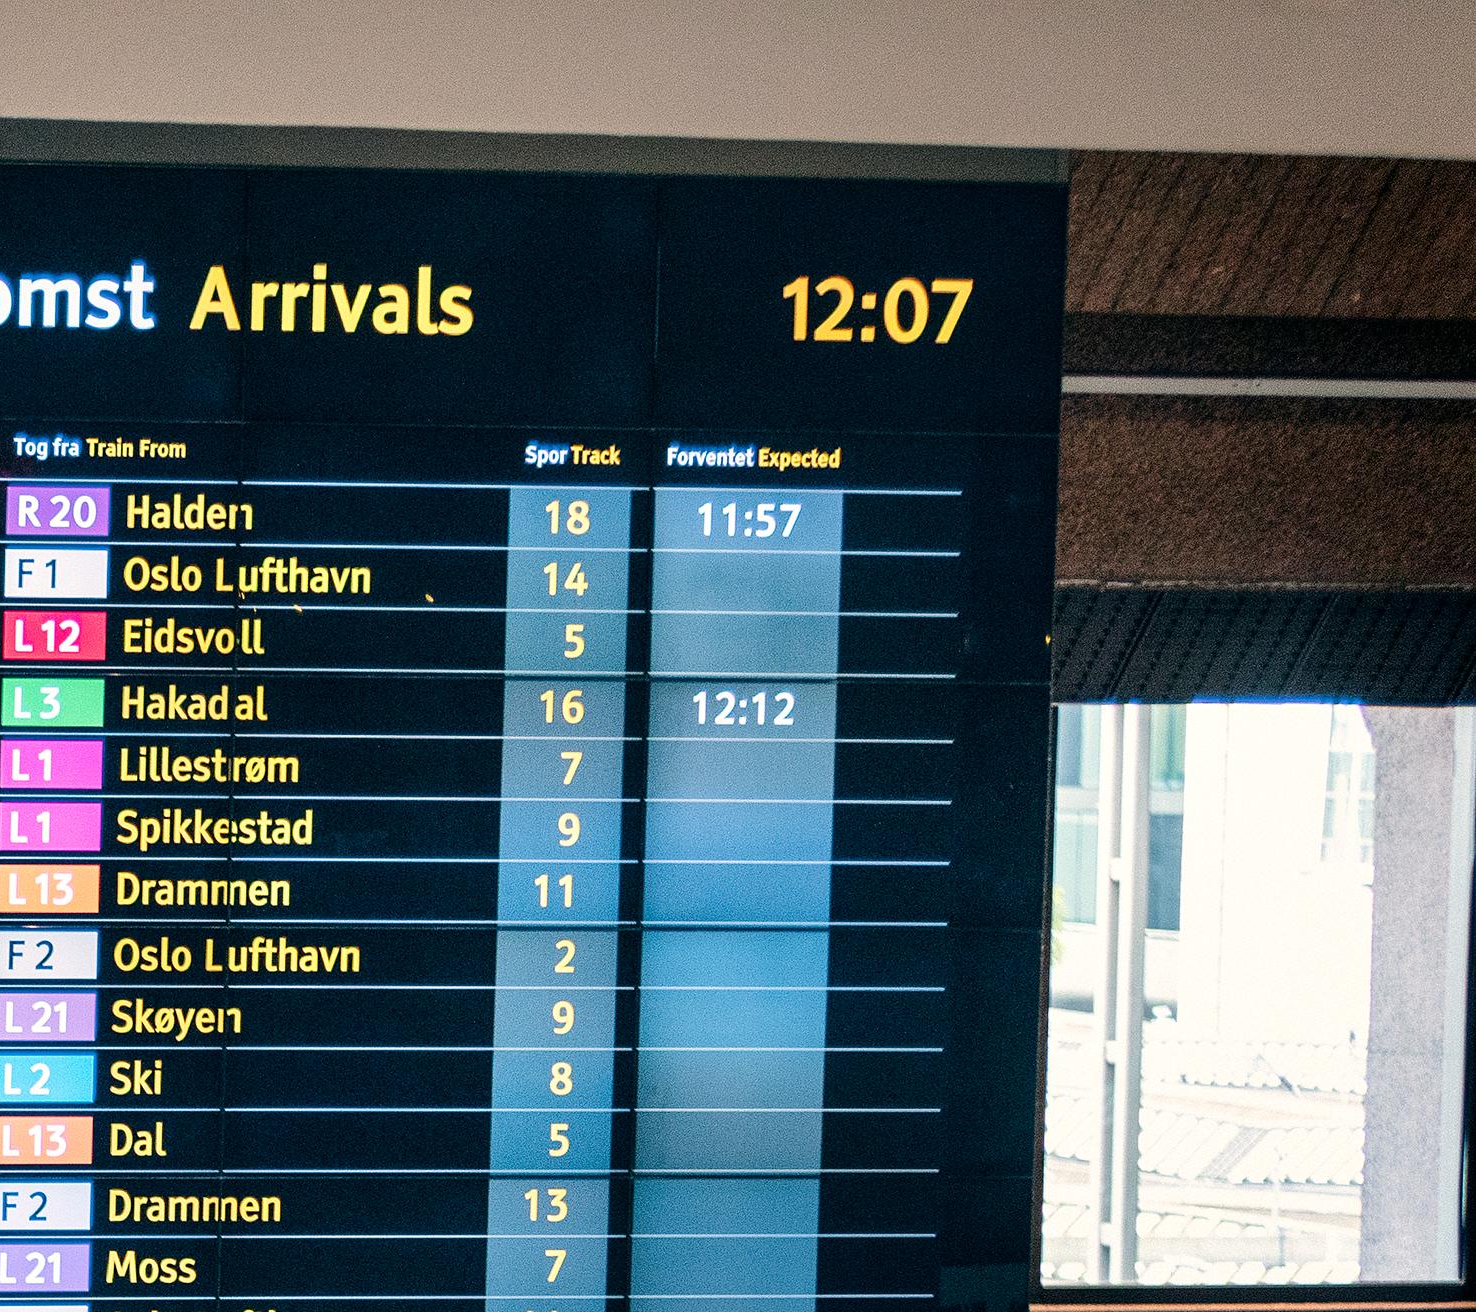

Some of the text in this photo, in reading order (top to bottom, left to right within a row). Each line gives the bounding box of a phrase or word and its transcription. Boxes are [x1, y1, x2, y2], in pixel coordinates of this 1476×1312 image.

[190, 264, 473, 335] Arrivals
[783, 277, 973, 343] 12:07
[14, 437, 186, 460] Tog fra Train From
[526, 445, 620, 468] Spor Track
[668, 446, 840, 471] Forventet Expected
[127, 494, 252, 529] Halden
[546, 501, 589, 534] 18
[699, 503, 801, 537] 11:57
[124, 556, 201, 591] Oslo
[216, 557, 370, 593] Lufthavn
[544, 563, 588, 595] 14
[122, 685, 267, 720] Hakadal
[541, 691, 584, 723] 16
[694, 691, 794, 725] 12:12
[117, 808, 312, 851] Spikkestad
[558, 813, 580, 846] 9
[110, 1060, 162, 1094] Ski
[550, 1063, 572, 1095] 8
[109, 1189, 280, 1222] Drammen
[525, 1189, 567, 1221] 13
[106, 1251, 196, 1283] Moss
[545, 1250, 566, 1282] 7
